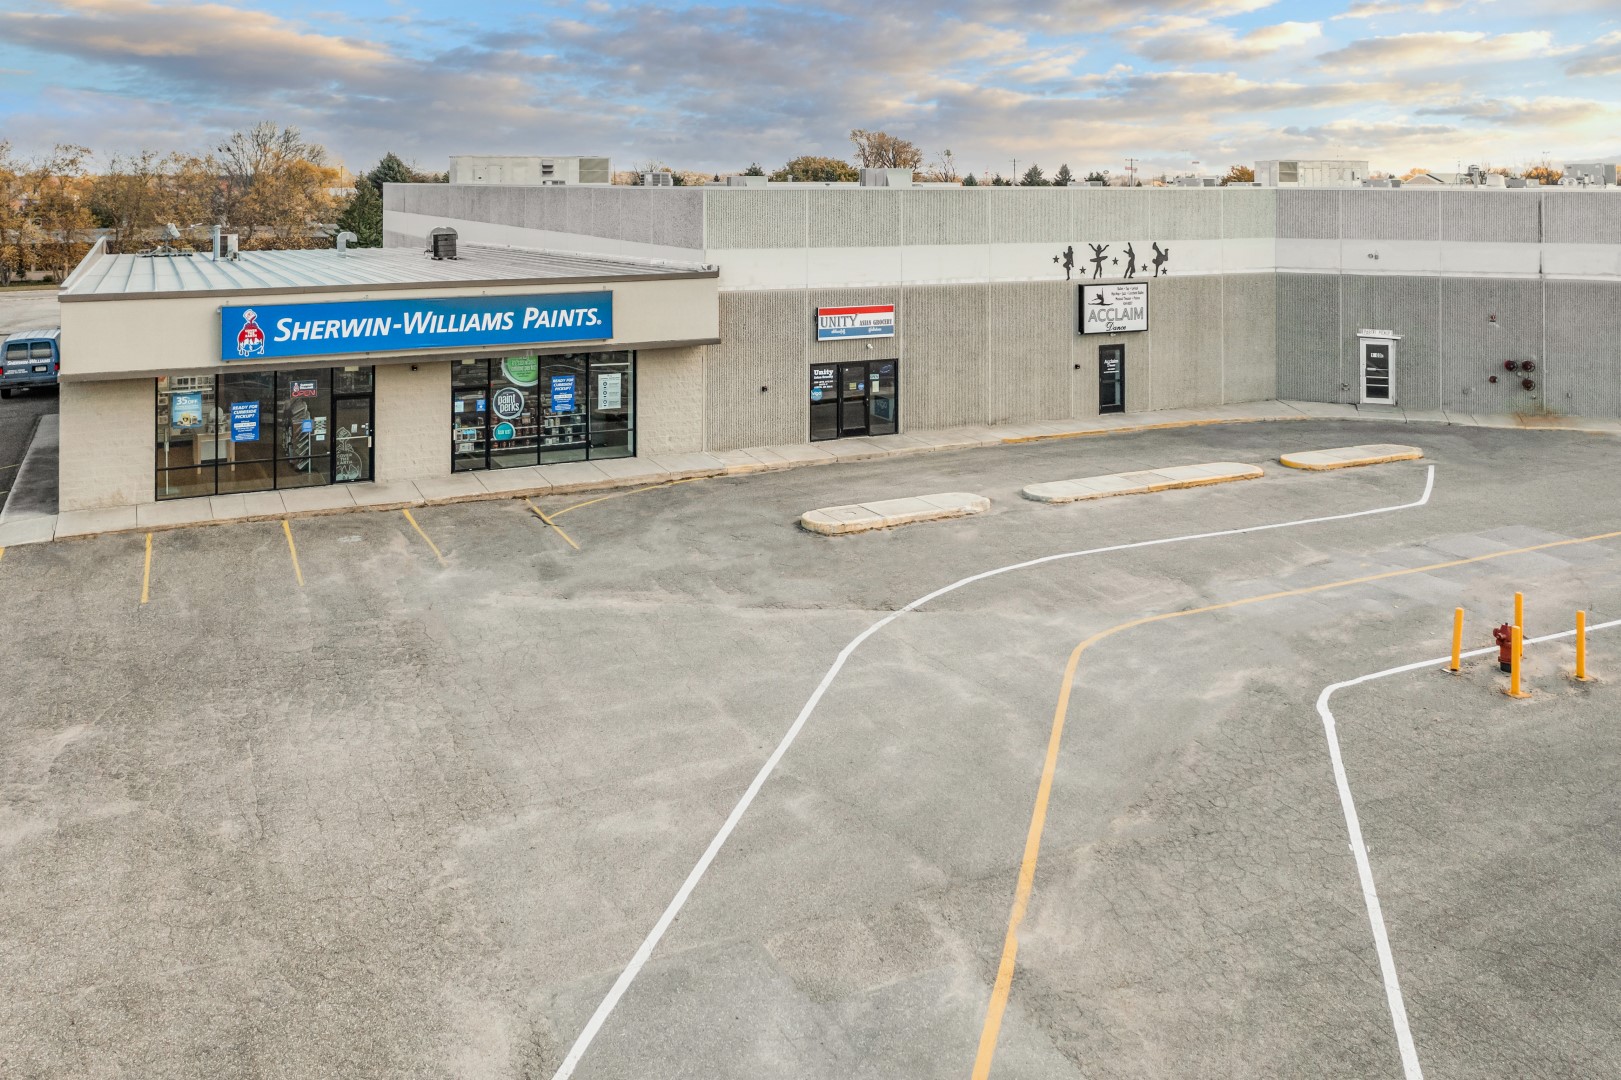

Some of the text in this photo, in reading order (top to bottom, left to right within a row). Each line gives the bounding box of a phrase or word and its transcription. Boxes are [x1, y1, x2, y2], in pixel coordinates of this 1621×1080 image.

[1088, 306, 1144, 322] ACCLAIM
[274, 311, 514, 342] SHERWIN-WILLIAMS
[820, 314, 858, 328] UNITY
[1106, 322, 1126, 332] Dance
[498, 394, 515, 406] paint
[500, 402, 520, 413] perks
